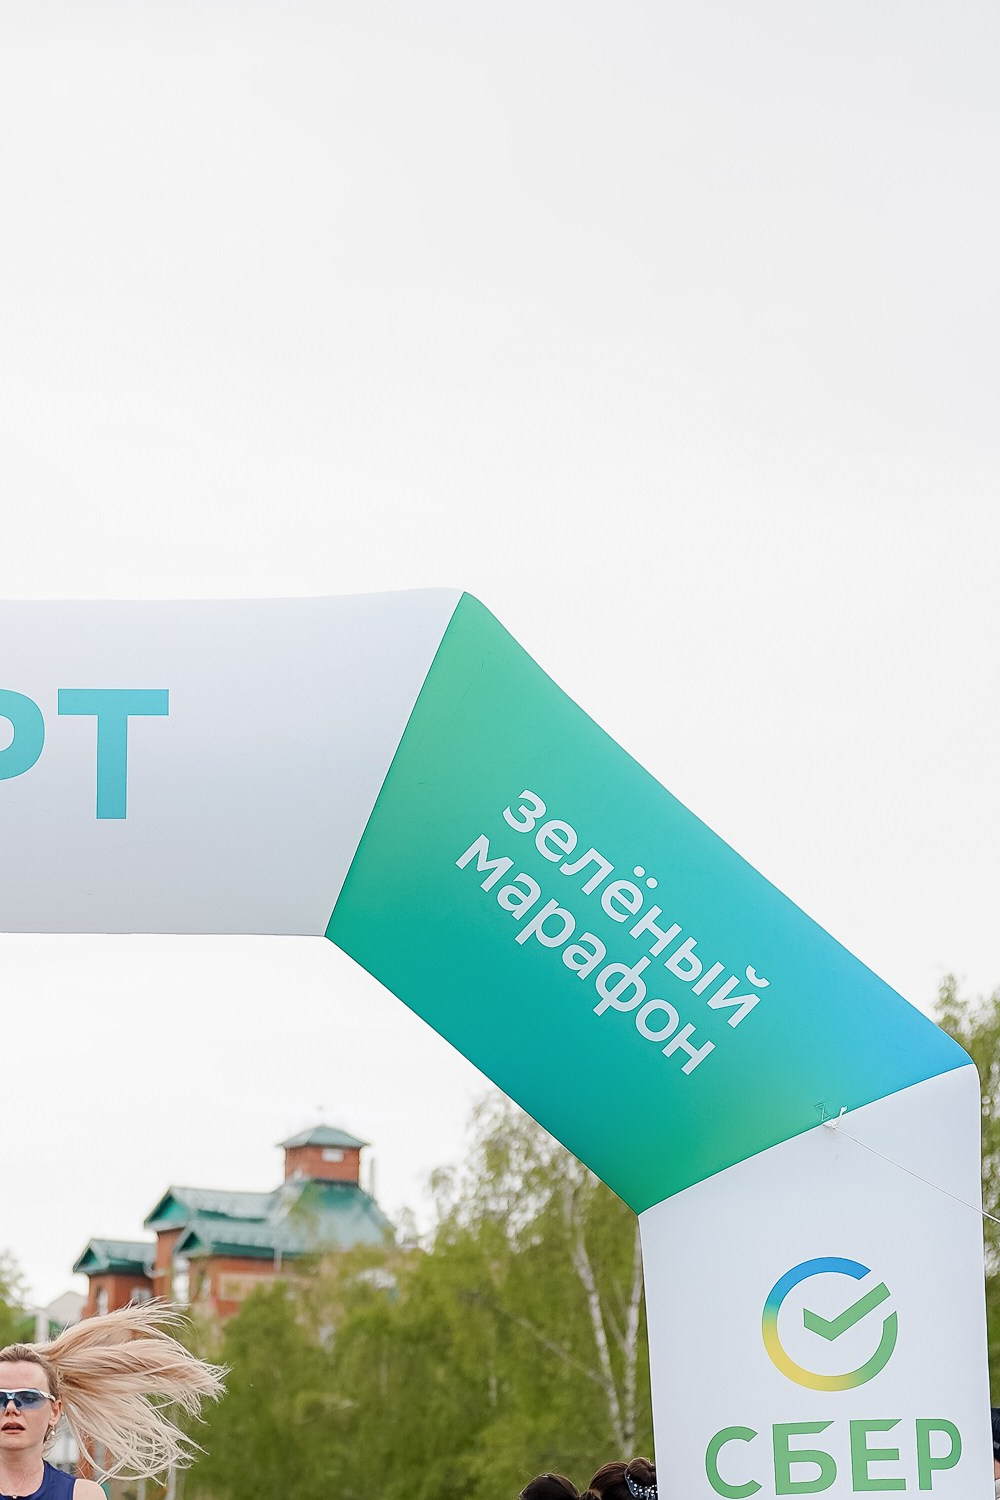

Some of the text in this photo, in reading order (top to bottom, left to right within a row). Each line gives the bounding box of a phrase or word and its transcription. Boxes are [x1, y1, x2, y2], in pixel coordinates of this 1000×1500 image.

[455, 834, 716, 1075] марафон
[502, 789, 770, 1028] зелёный
[705, 1418, 962, 1499] СБЕР
